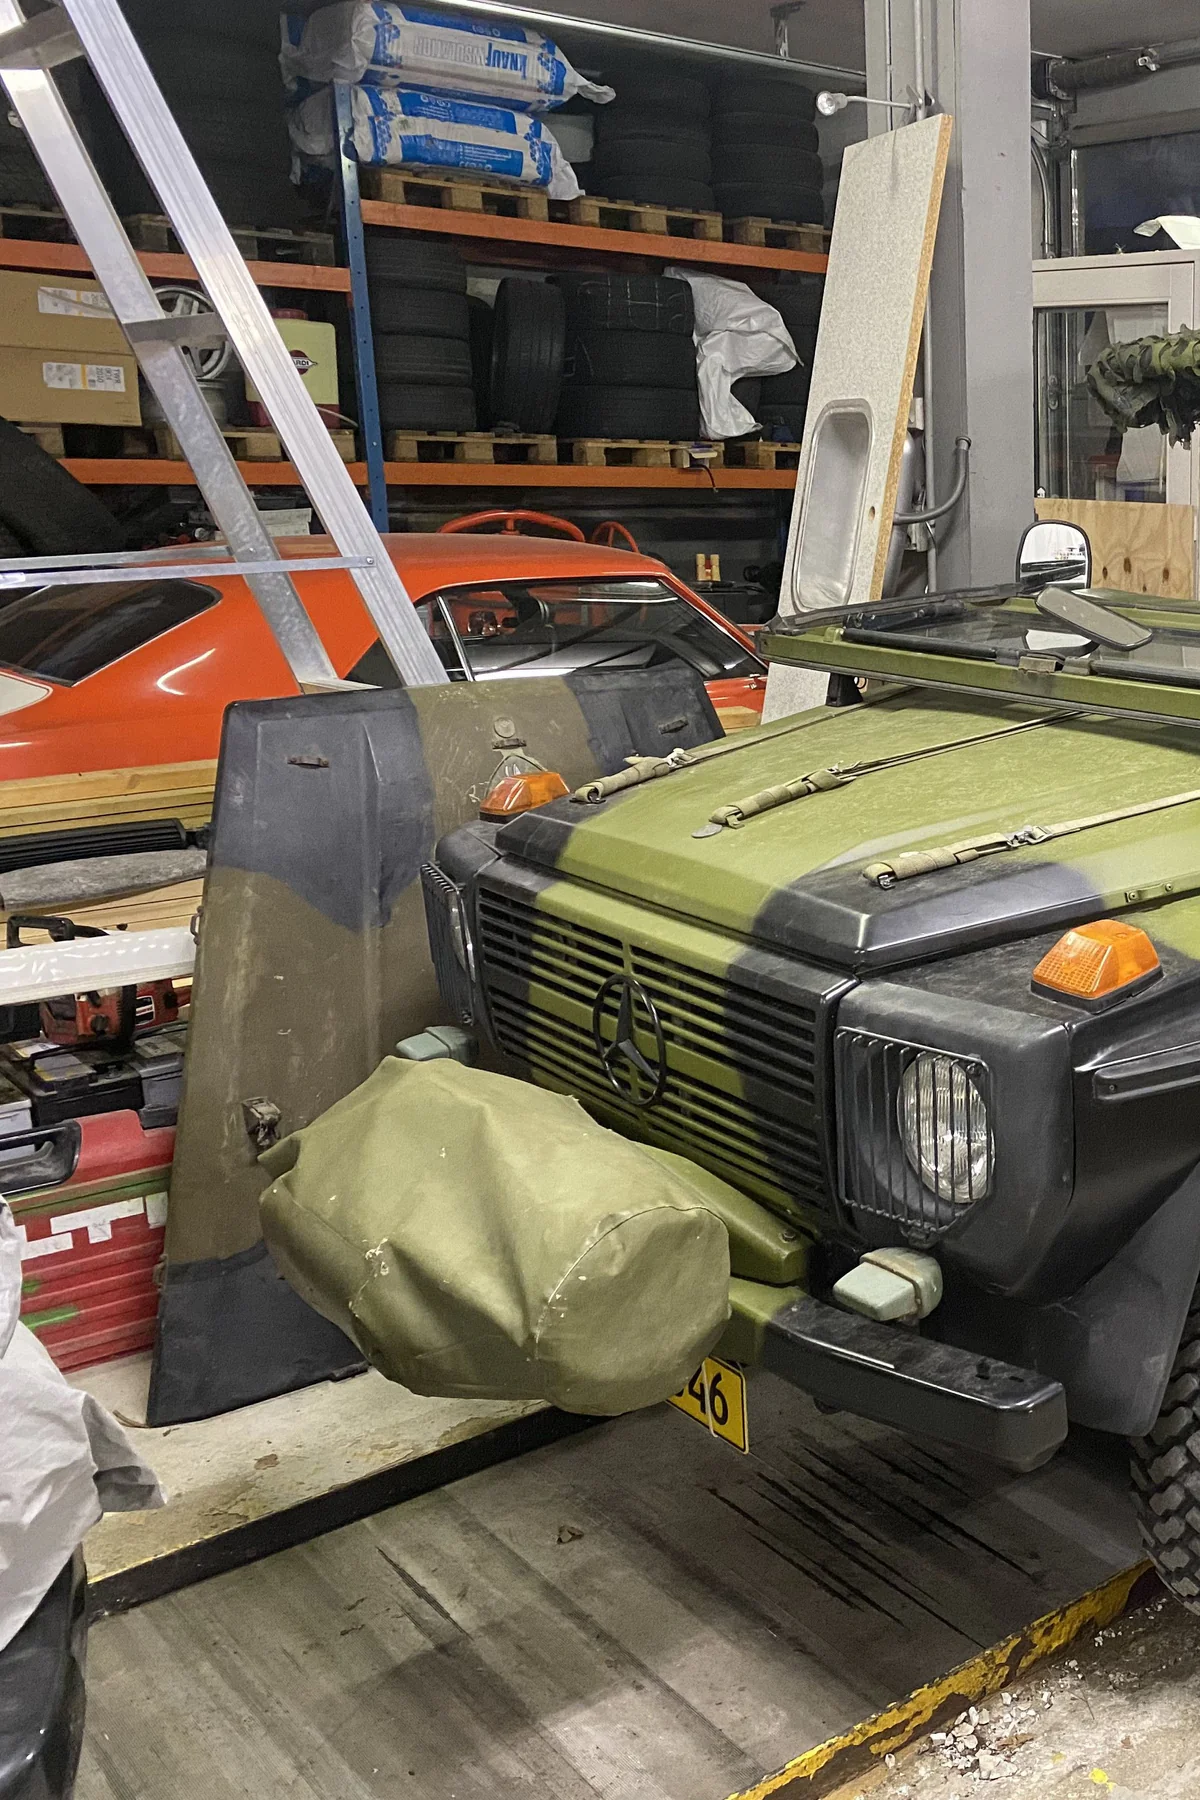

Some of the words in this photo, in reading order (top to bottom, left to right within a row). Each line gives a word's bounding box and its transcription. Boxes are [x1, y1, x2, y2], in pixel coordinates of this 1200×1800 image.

[413, 36, 486, 66] INSULATION
[485, 42, 528, 80] KNAUF
[675, 1365, 729, 1426] 46
